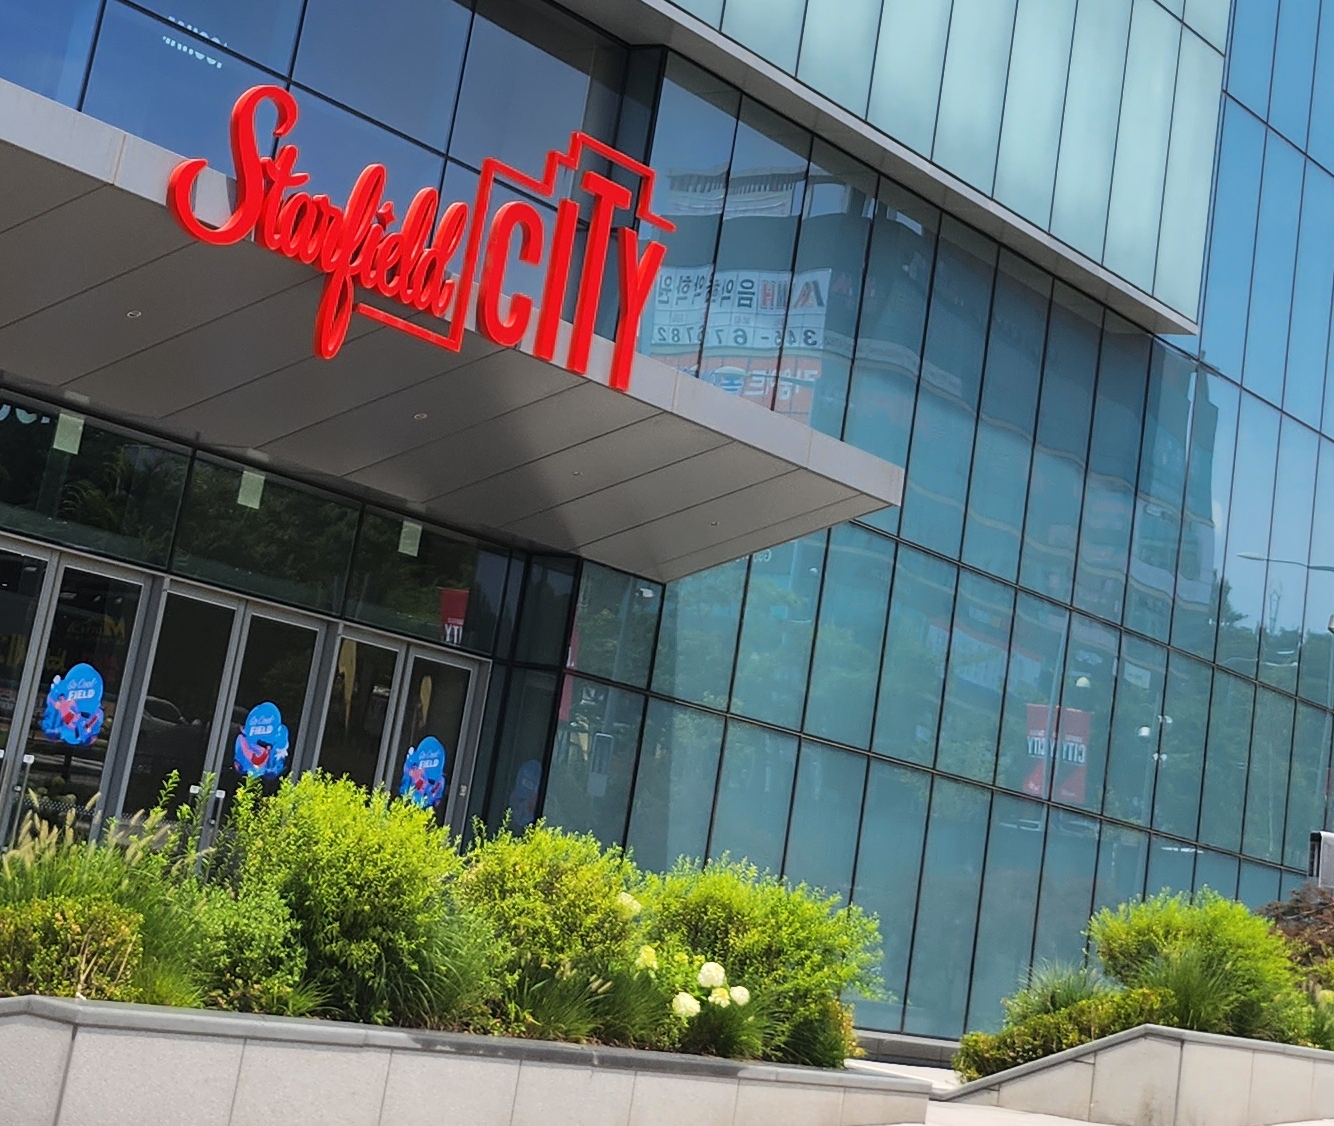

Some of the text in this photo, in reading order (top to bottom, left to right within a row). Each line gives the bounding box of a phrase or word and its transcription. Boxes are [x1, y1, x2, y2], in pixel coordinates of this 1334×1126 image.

[168, 85, 667, 392] Starfield CITY
[68, 689, 95, 702] FIELD
